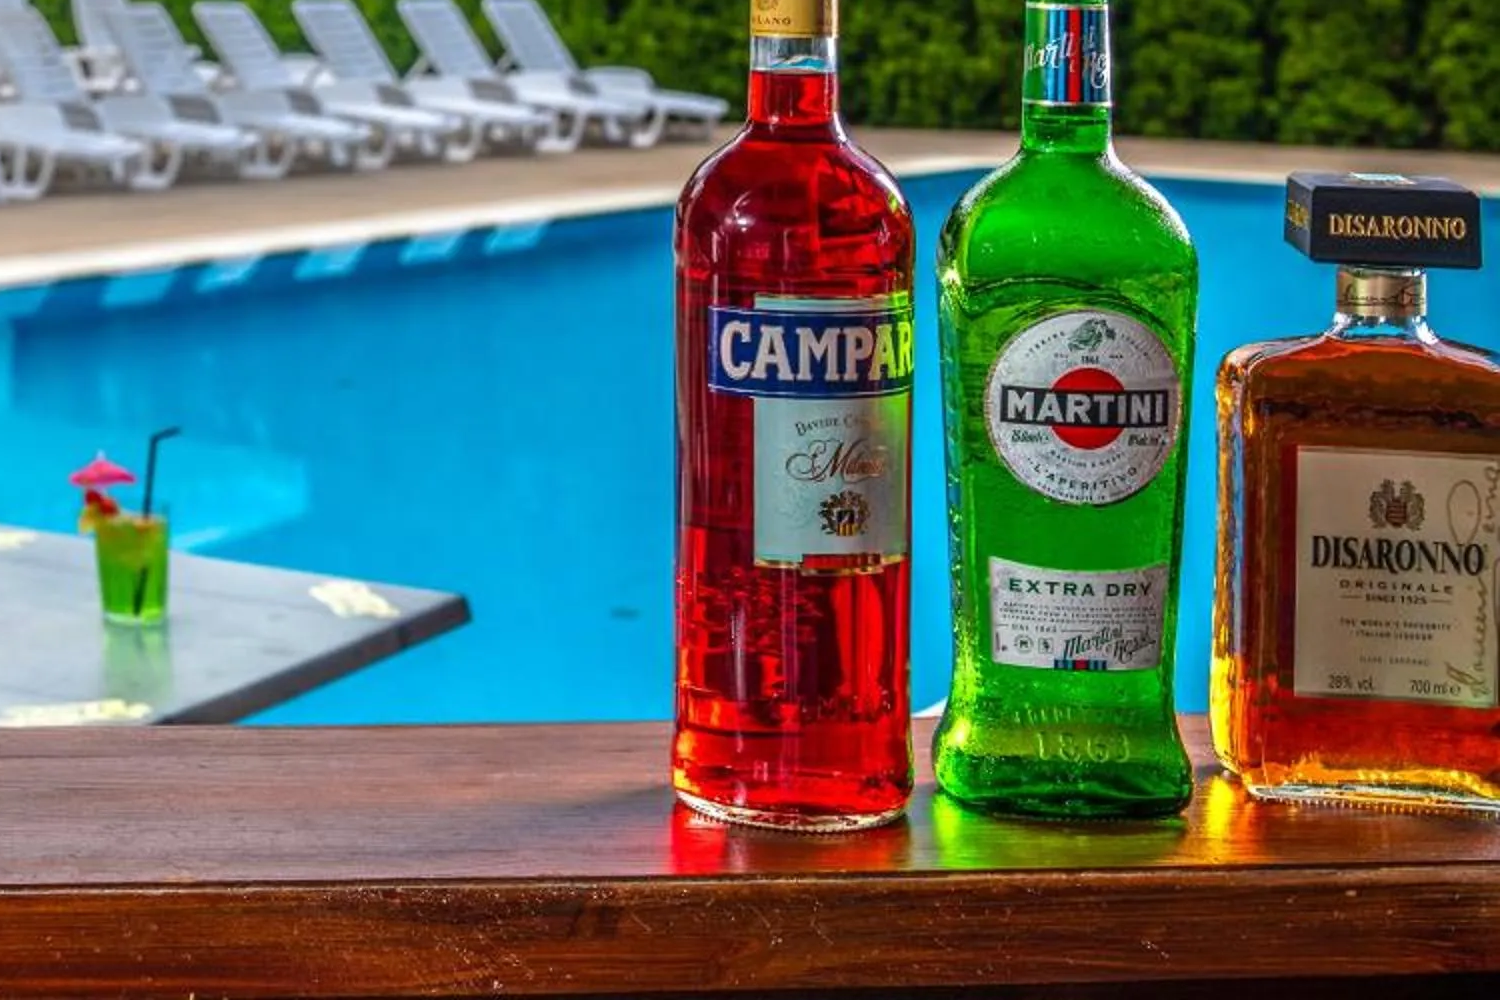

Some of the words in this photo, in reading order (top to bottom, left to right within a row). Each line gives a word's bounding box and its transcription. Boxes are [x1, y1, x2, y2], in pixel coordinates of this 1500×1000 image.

[752, 15, 792, 25] LANO
[1329, 213, 1467, 240] DISARONNO
[719, 320, 915, 381] CAMPAR
[1007, 389, 1164, 425] MARTINI
[1311, 536, 1485, 576] DISARONNO
[1008, 577, 1096, 597] EXTRA
[1105, 582, 1153, 597] DRY
[1339, 579, 1454, 594] ORIGINALE
[1365, 593, 1396, 603] SINCE
[1328, 674, 1352, 690] 28%
[1410, 679, 1431, 694] 700
